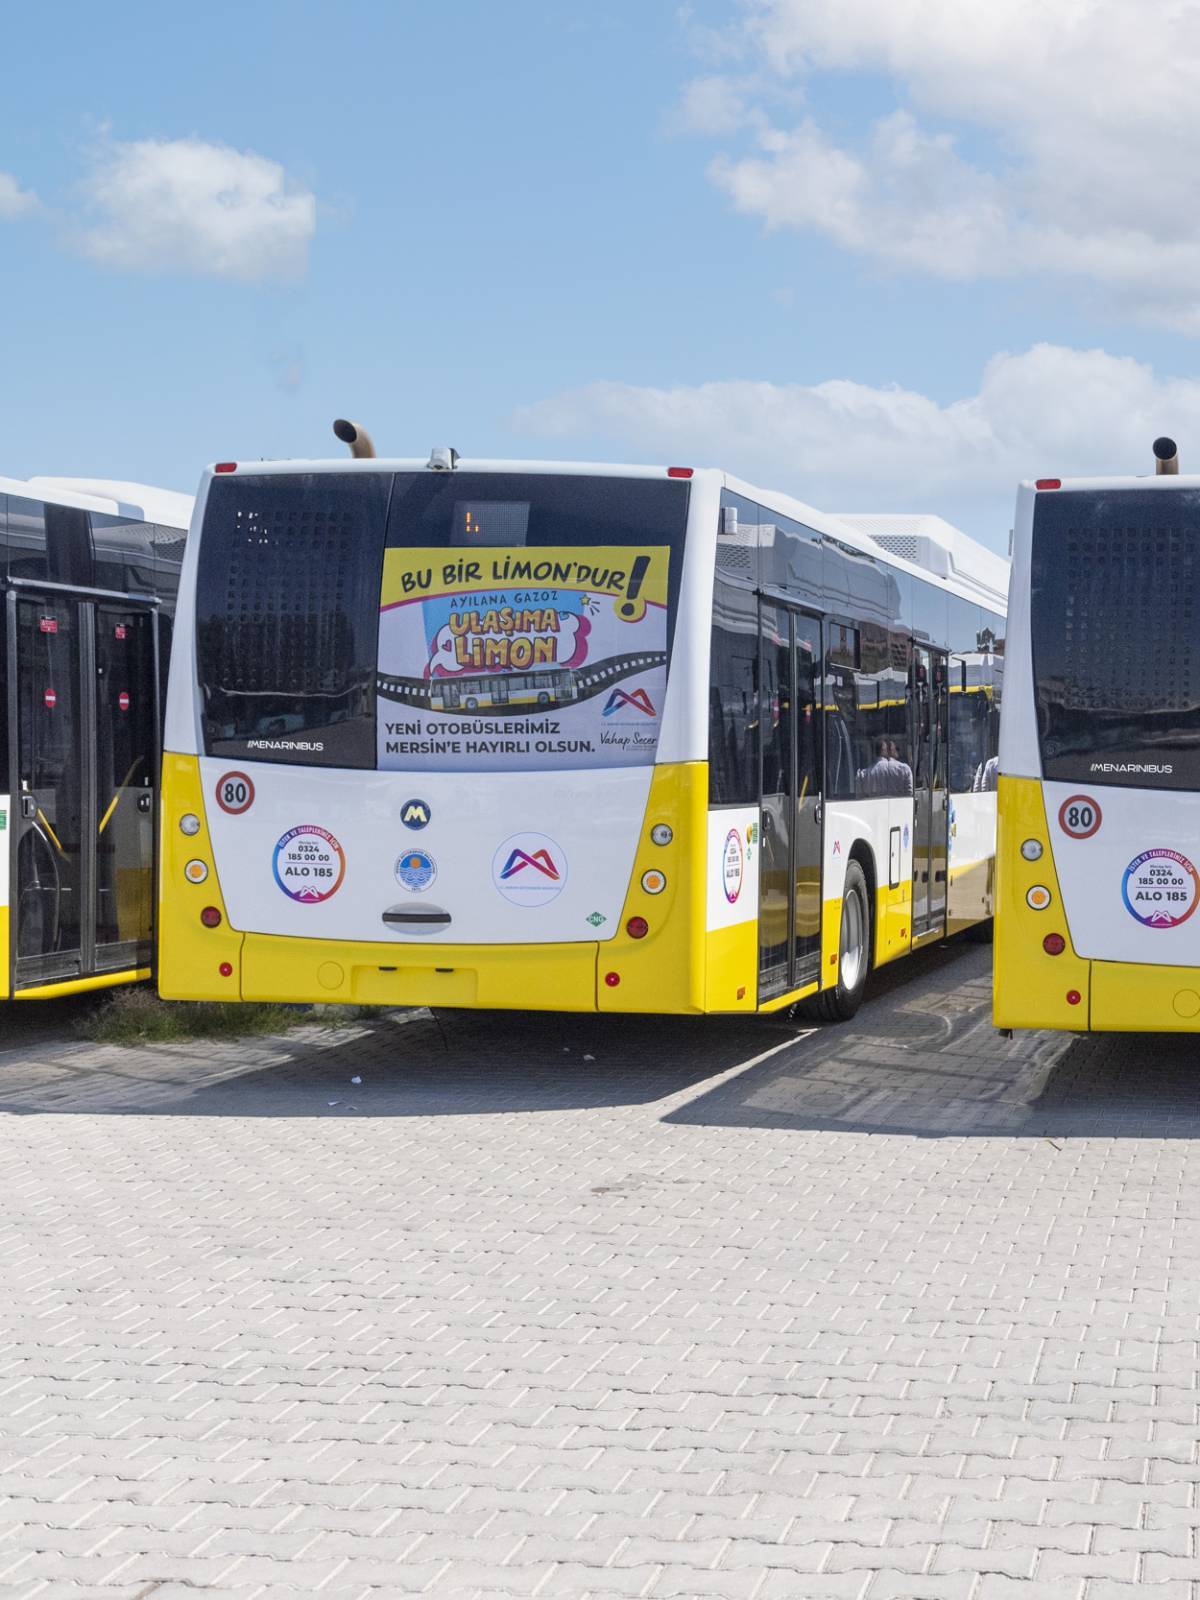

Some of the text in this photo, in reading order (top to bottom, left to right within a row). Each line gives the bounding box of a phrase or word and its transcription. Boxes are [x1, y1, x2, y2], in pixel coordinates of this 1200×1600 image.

[401, 568, 432, 593] BU
[442, 558, 483, 586] BİR
[450, 590, 559, 609] AYILANA GAZOZ
[448, 605, 561, 638] ULAŞIMA
[453, 634, 558, 670] LİMON
[385, 719, 561, 736] YENİ OTOBÜSLERİMİZ
[466, 739, 529, 754] HAYIRLI
[534, 739, 595, 753] OLSUN.
[600, 731, 632, 750] Vahap
[224, 783, 247, 803] 80
[1068, 806, 1093, 828] 80
[288, 853, 302, 861] 185
[298, 845, 320, 853] 0324
[285, 867, 333, 877] ALO 185
[1149, 869, 1173, 877] 0324
[1138, 877, 1154, 885] 185
[1135, 891, 1187, 902] ALO 185
